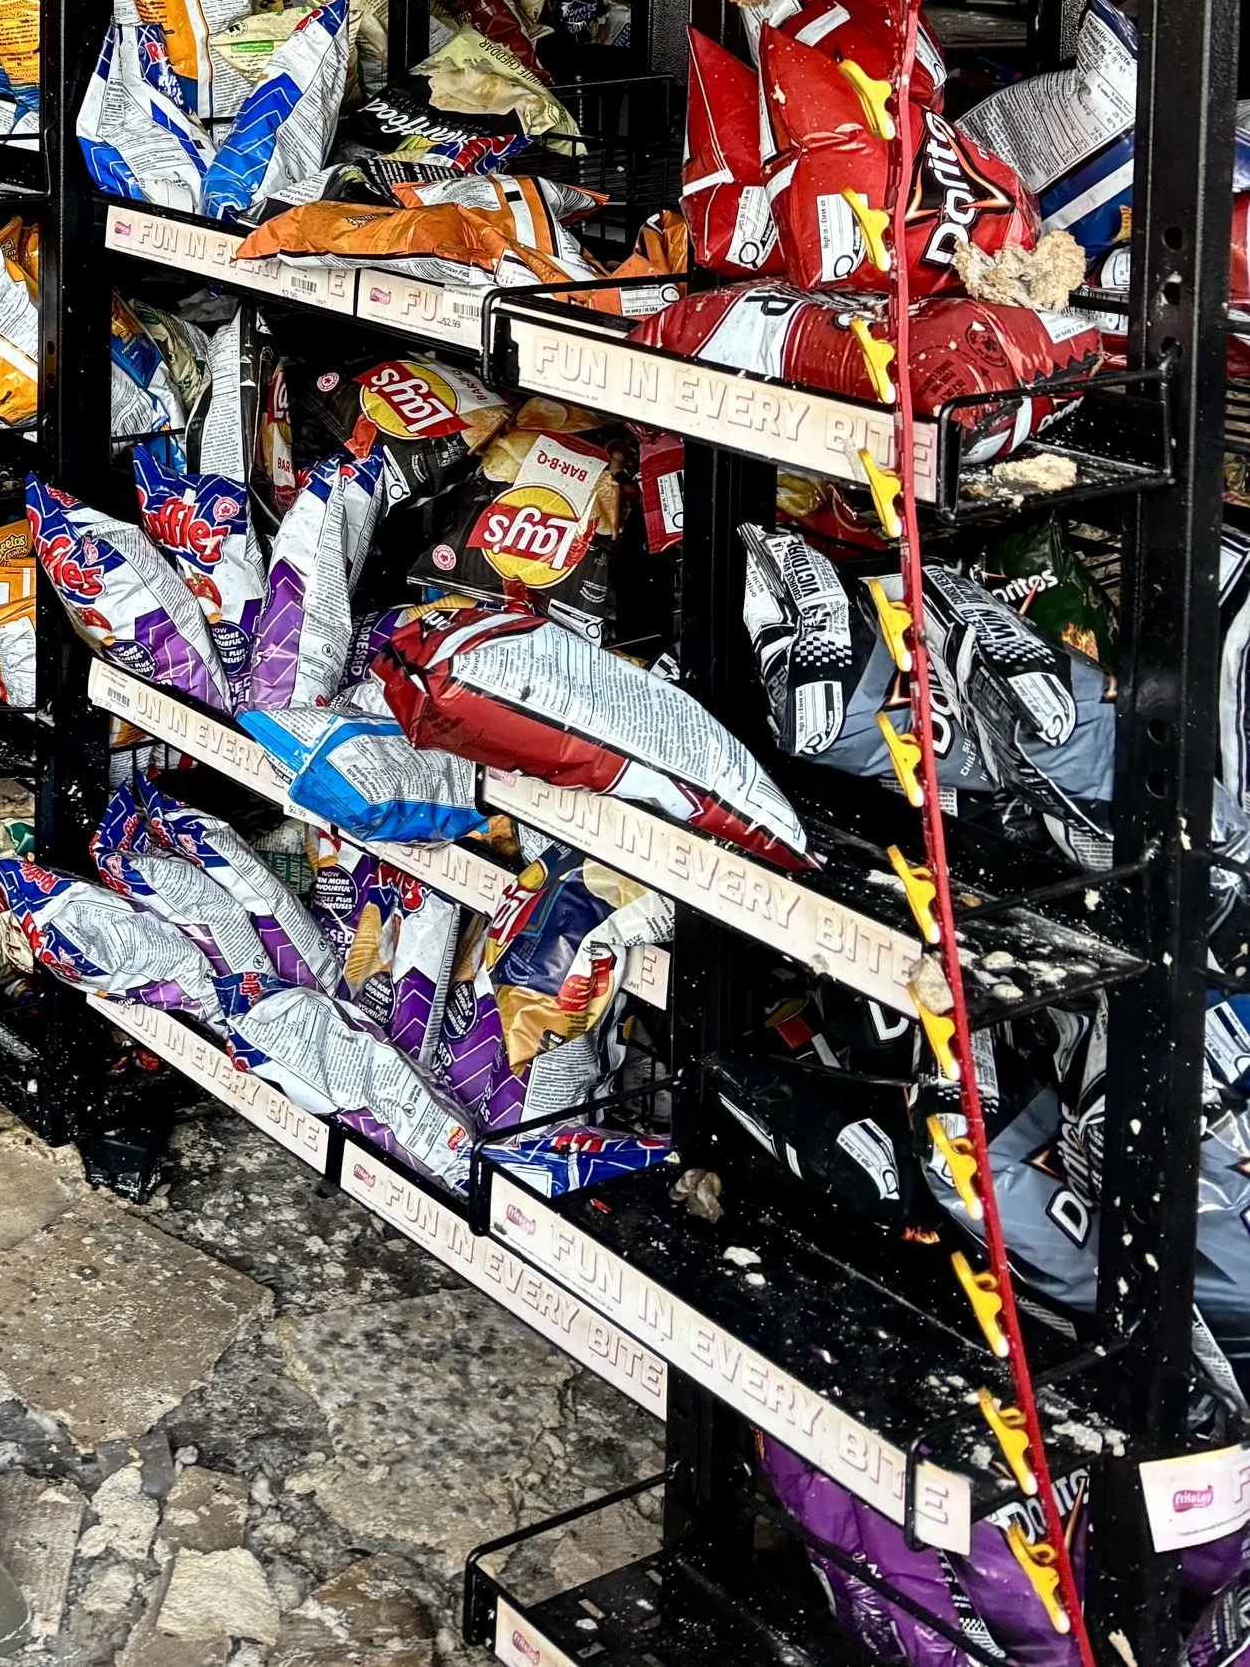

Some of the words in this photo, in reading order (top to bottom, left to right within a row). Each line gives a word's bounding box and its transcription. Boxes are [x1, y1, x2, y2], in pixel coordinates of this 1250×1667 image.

[479, 40, 521, 77] CHEDDAR
[357, 98, 478, 147] martfood
[925, 111, 978, 266] Doritos
[138, 219, 179, 253] FUN
[185, 230, 207, 260] IN
[401, 285, 443, 324] FU
[441, 316, 462, 329] $2.99
[369, 368, 451, 433] Lay's
[534, 334, 611, 388] FUN
[621, 355, 658, 403] IN
[666, 373, 811, 440] EVERY
[483, 505, 580, 571] Lay's
[788, 539, 821, 598] VICTOIRE
[220, 631, 239, 643] MORE
[351, 625, 372, 677] DRESSED
[137, 687, 162, 724] UN
[168, 702, 188, 738] IN
[195, 718, 267, 776] EVERY
[316, 883, 354, 893] AVOURFUL
[321, 870, 340, 878] NOW
[329, 877, 350, 886] MORE
[441, 850, 472, 886] IN
[531, 784, 603, 838] FUN
[614, 805, 653, 862] IN
[667, 838, 801, 929] EVERY
[814, 901, 926, 992] BITE
[334, 896, 352, 904] PLUS
[165, 1022, 186, 1056] IN
[191, 1044, 262, 1106] EVERY
[266, 1095, 322, 1152] BITE
[385, 1174, 439, 1238] FUN
[447, 1222, 476, 1265] IN
[484, 1240, 580, 1334] EVERY
[588, 1315, 665, 1398] BITE
[550, 1224, 624, 1305] FUN
[638, 1281, 675, 1341] IN
[688, 1320, 824, 1441] EVERY
[837, 1431, 953, 1525] BITE
[1174, 1488, 1214, 1512] FritoLay
